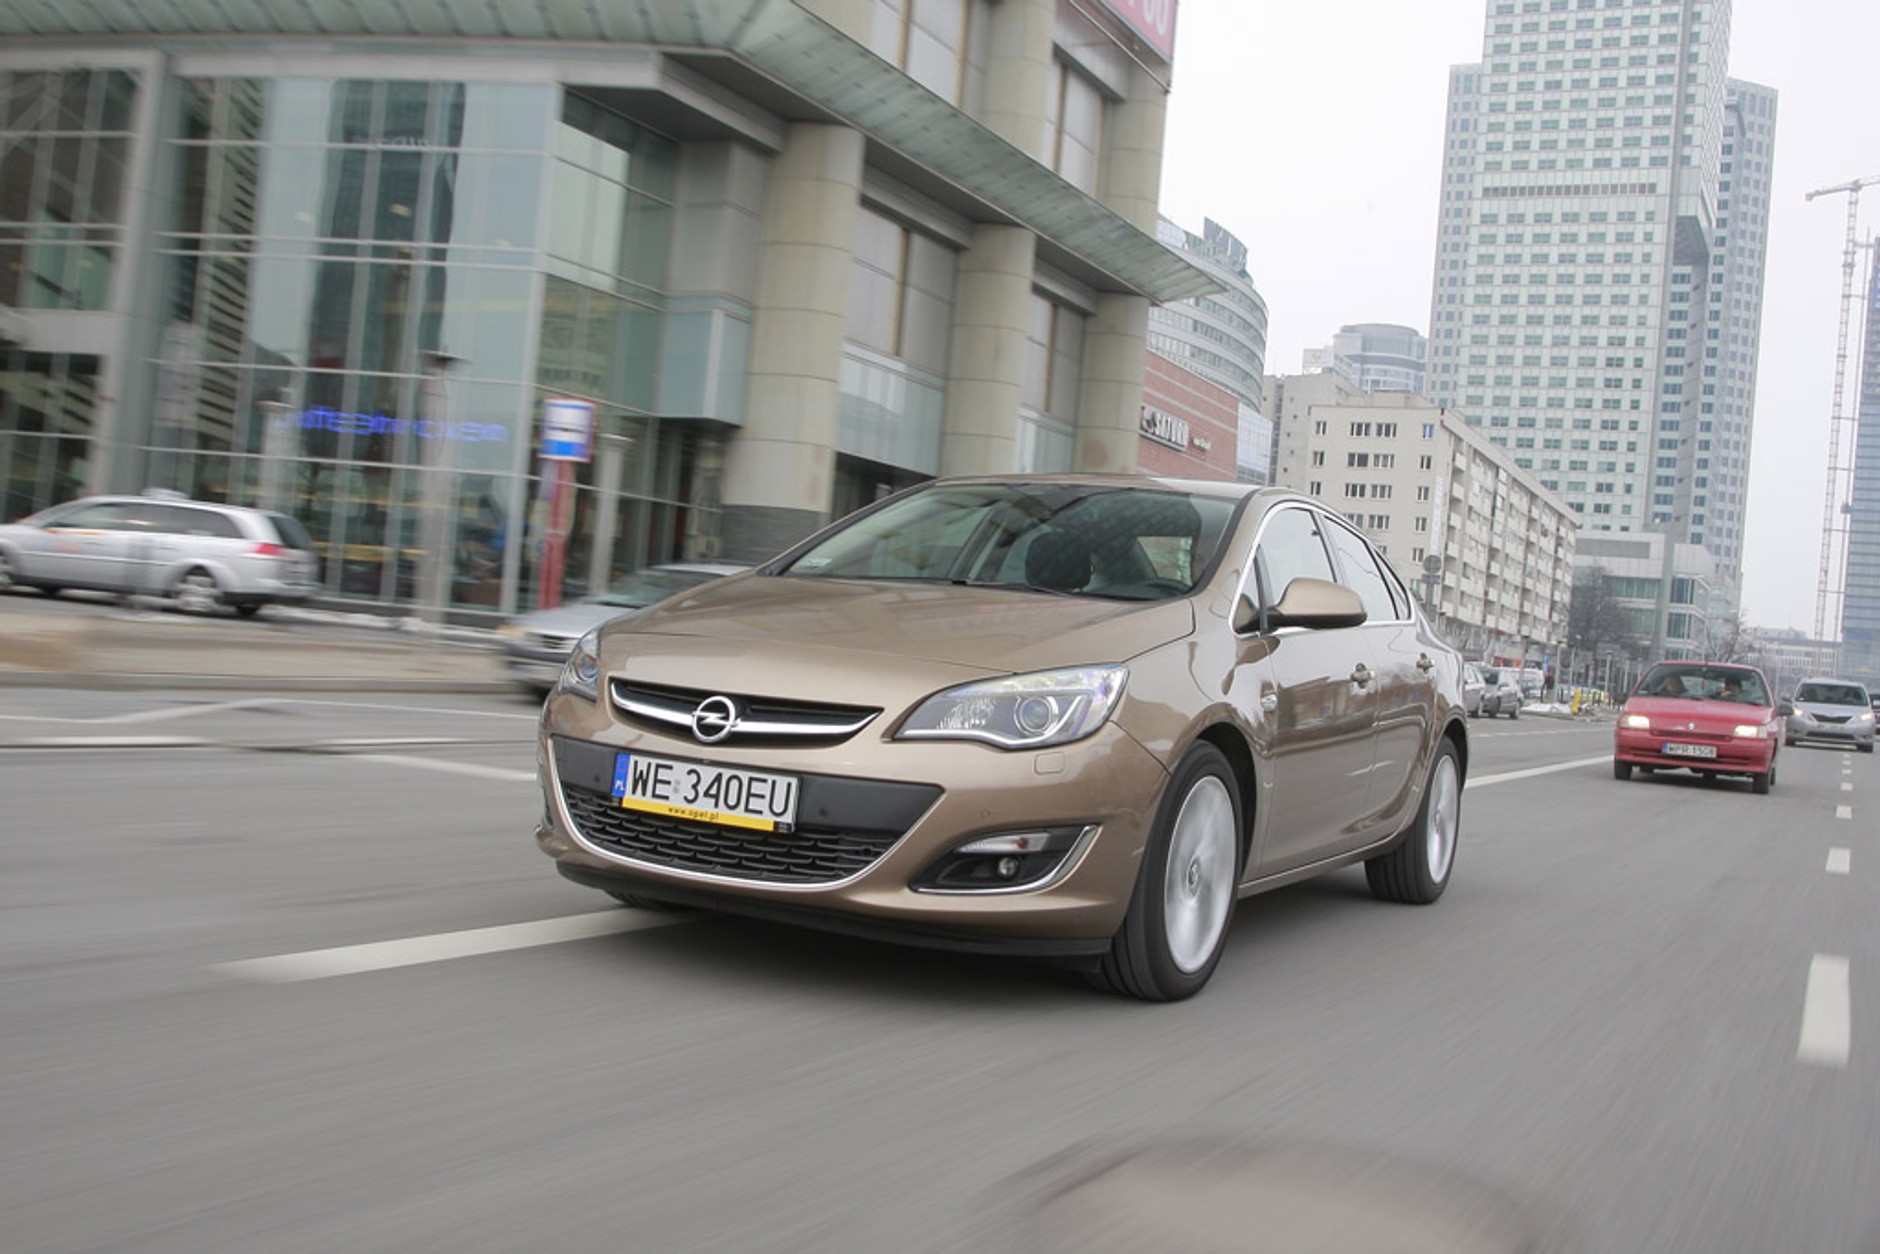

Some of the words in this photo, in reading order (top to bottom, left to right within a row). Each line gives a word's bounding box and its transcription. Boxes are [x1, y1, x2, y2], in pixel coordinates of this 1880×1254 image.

[615, 780, 625, 791] PL
[631, 759, 673, 800] WE
[683, 768, 791, 817] 340EU
[668, 807, 719, 821] www.opel.pl
